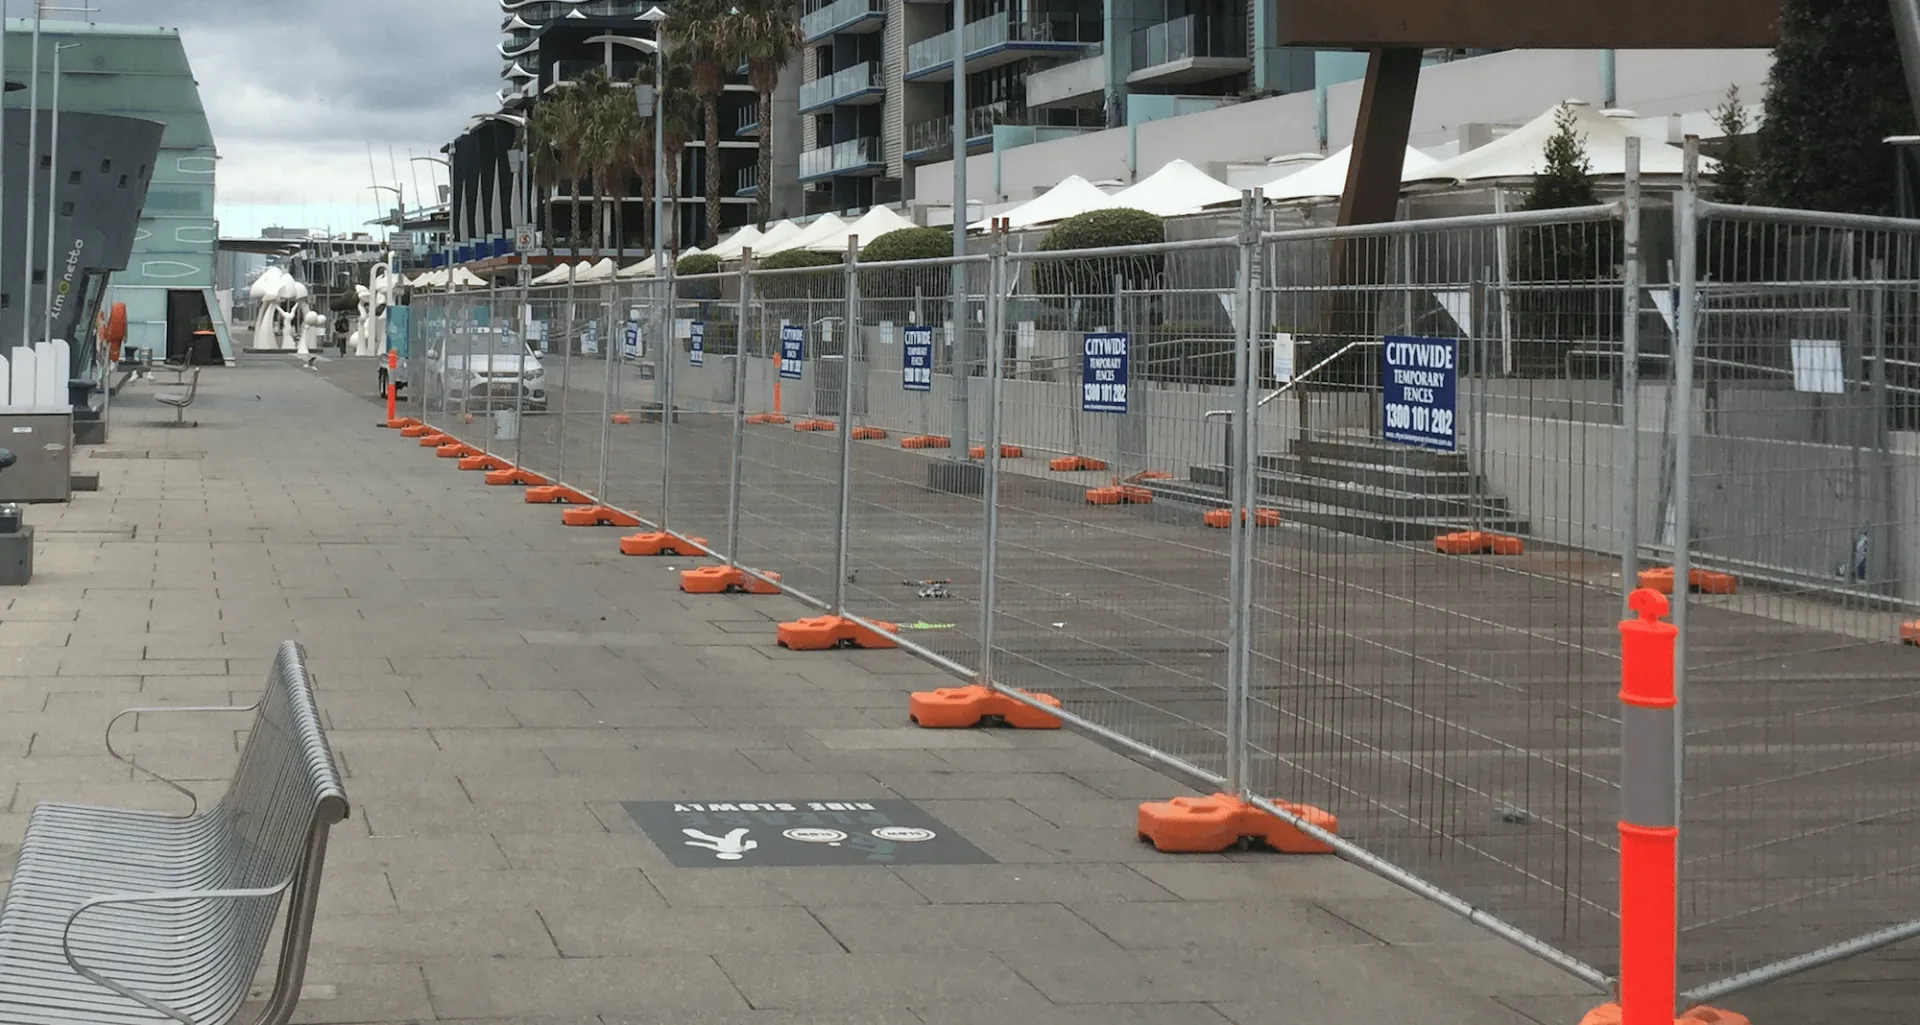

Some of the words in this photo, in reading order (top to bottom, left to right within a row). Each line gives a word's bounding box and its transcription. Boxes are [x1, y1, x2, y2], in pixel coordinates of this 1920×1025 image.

[1085, 337, 1127, 356] CITYWIDE
[1386, 342, 1453, 369] CITYWIDE
[1394, 369, 1445, 388] TEMPORARY
[1403, 386, 1434, 404] FENCES
[1385, 403, 1410, 429] 1300
[1412, 406, 1430, 432] 101
[1431, 408, 1453, 435] 202
[673, 803, 797, 812] SLOWLY
[807, 802, 876, 811] RIDE
